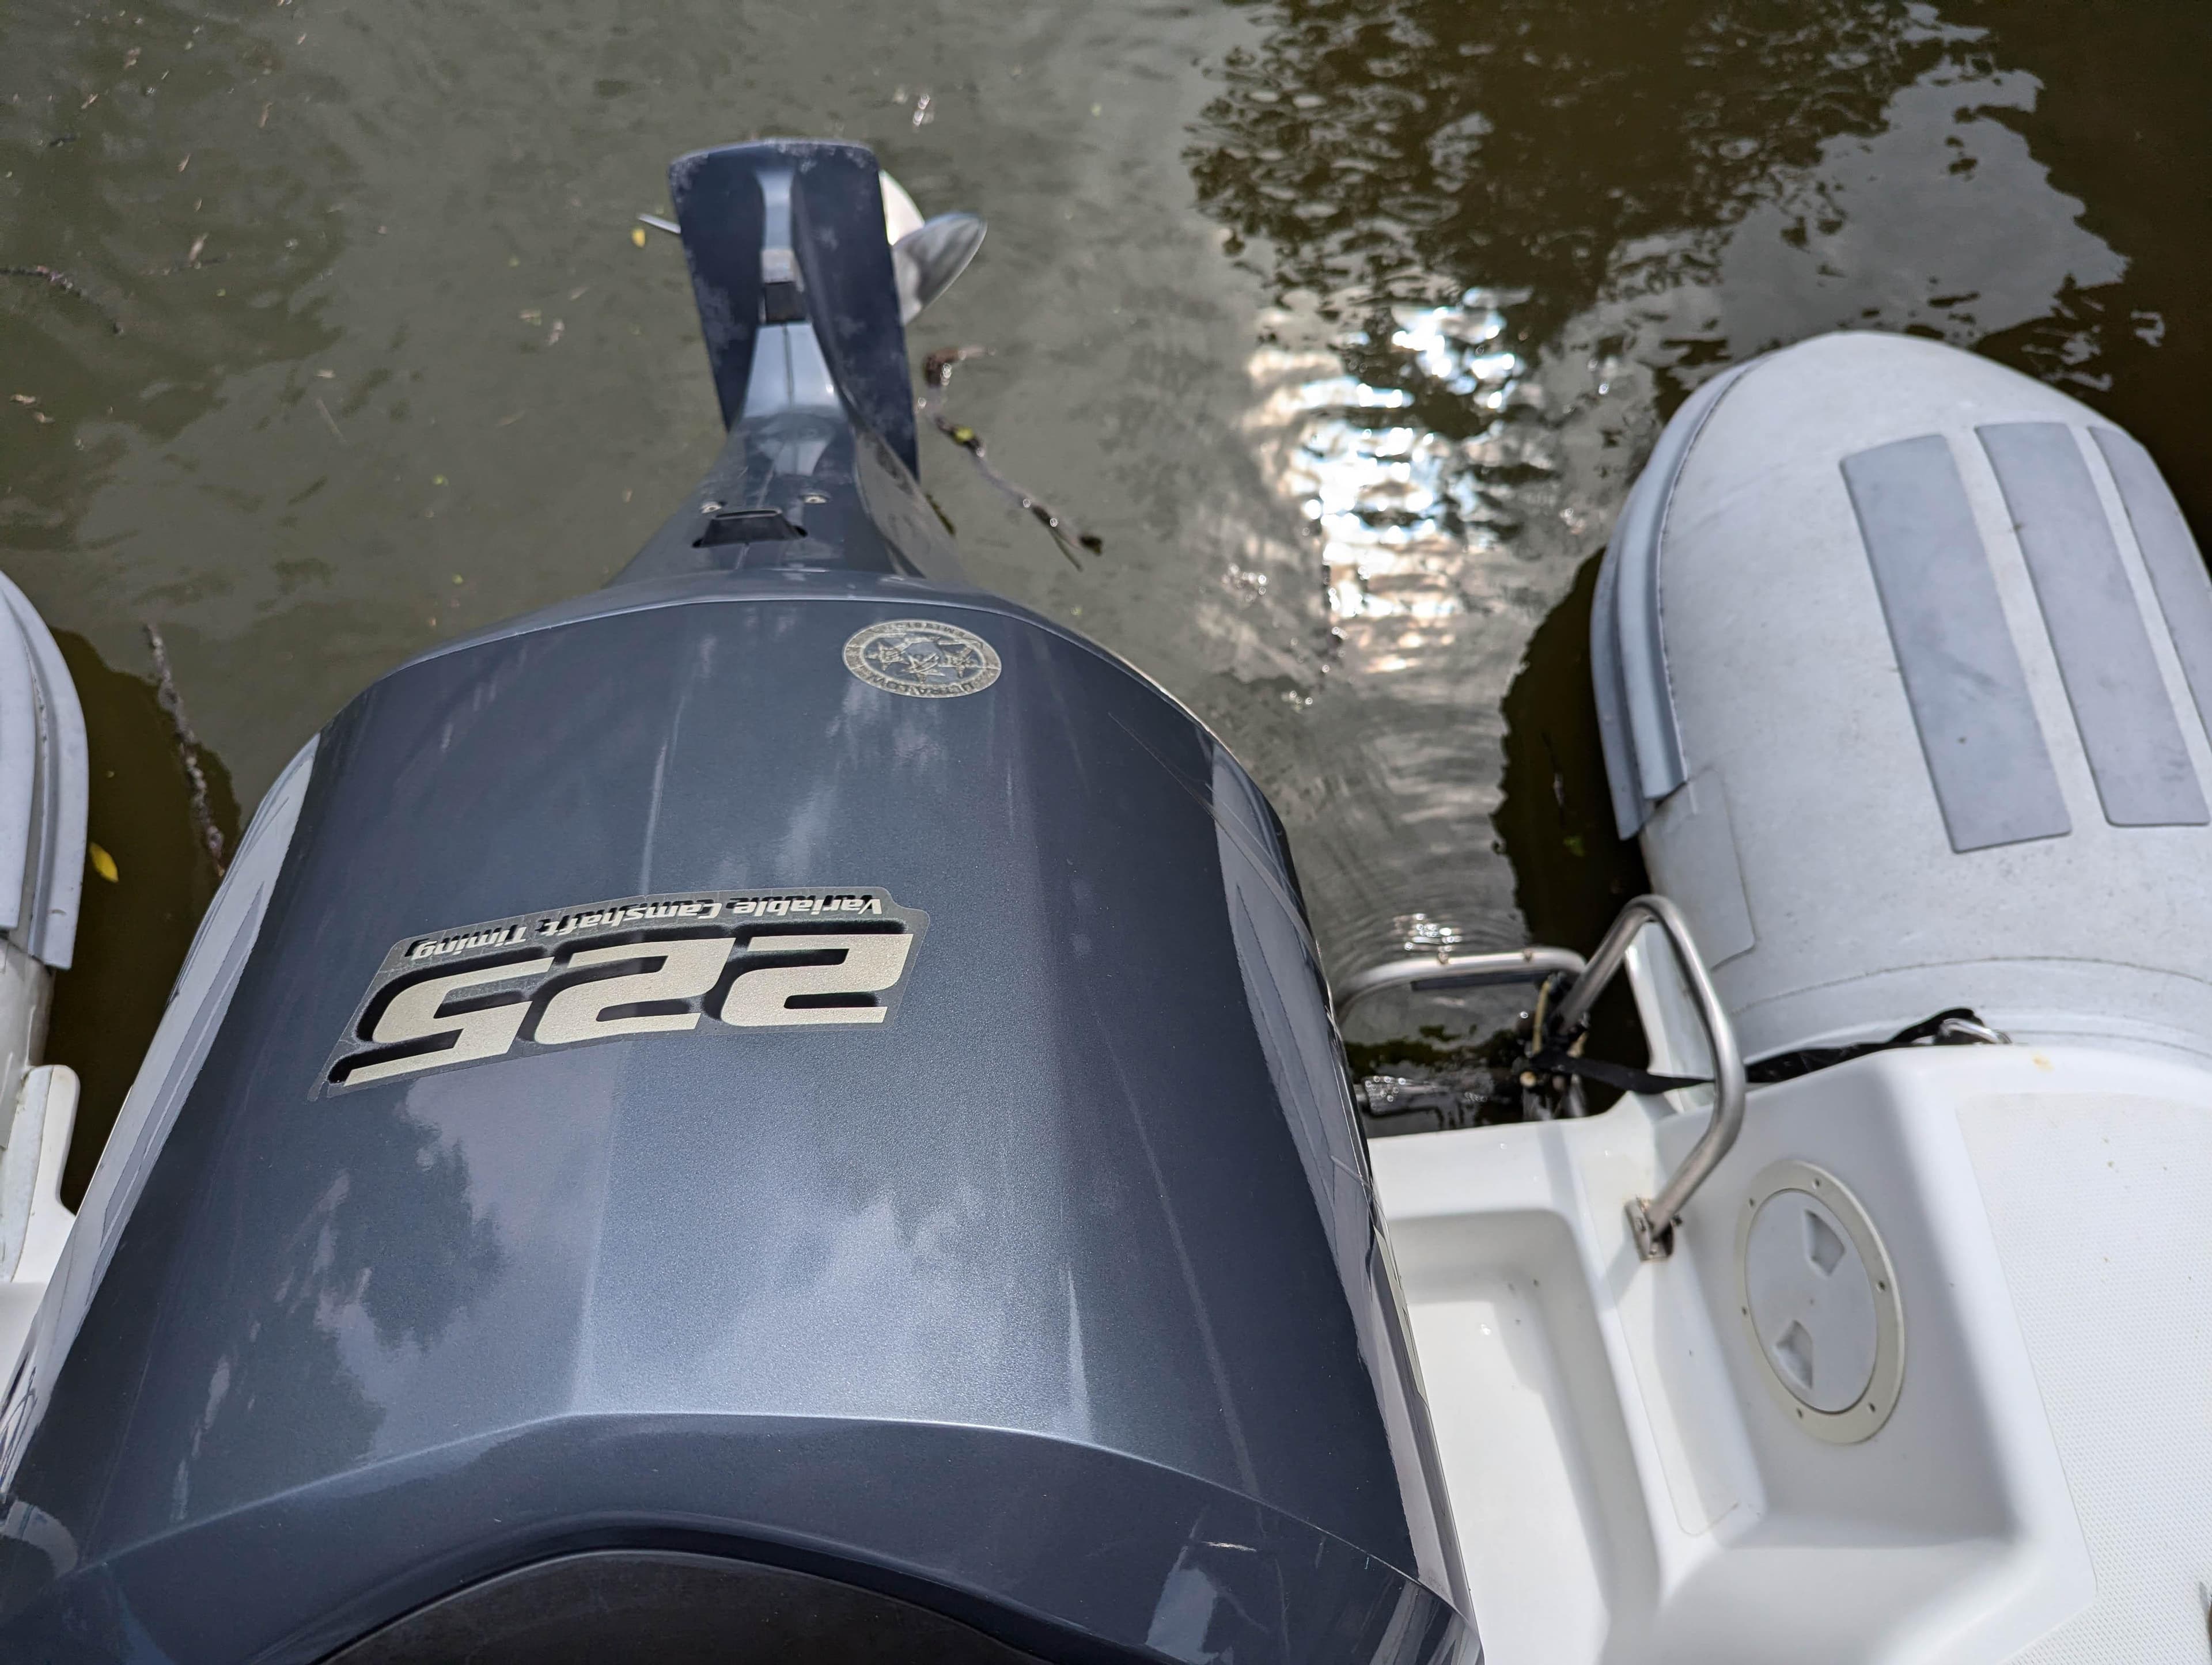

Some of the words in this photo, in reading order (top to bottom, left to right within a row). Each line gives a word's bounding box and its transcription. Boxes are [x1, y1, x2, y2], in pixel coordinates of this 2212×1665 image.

[870, 675, 910, 693] LOW
[915, 682, 974, 695] ULTRA
[538, 900, 721, 936] Camshaft
[732, 896, 882, 917] Variable
[411, 926, 528, 960] Timing
[342, 930, 914, 1086] 225
